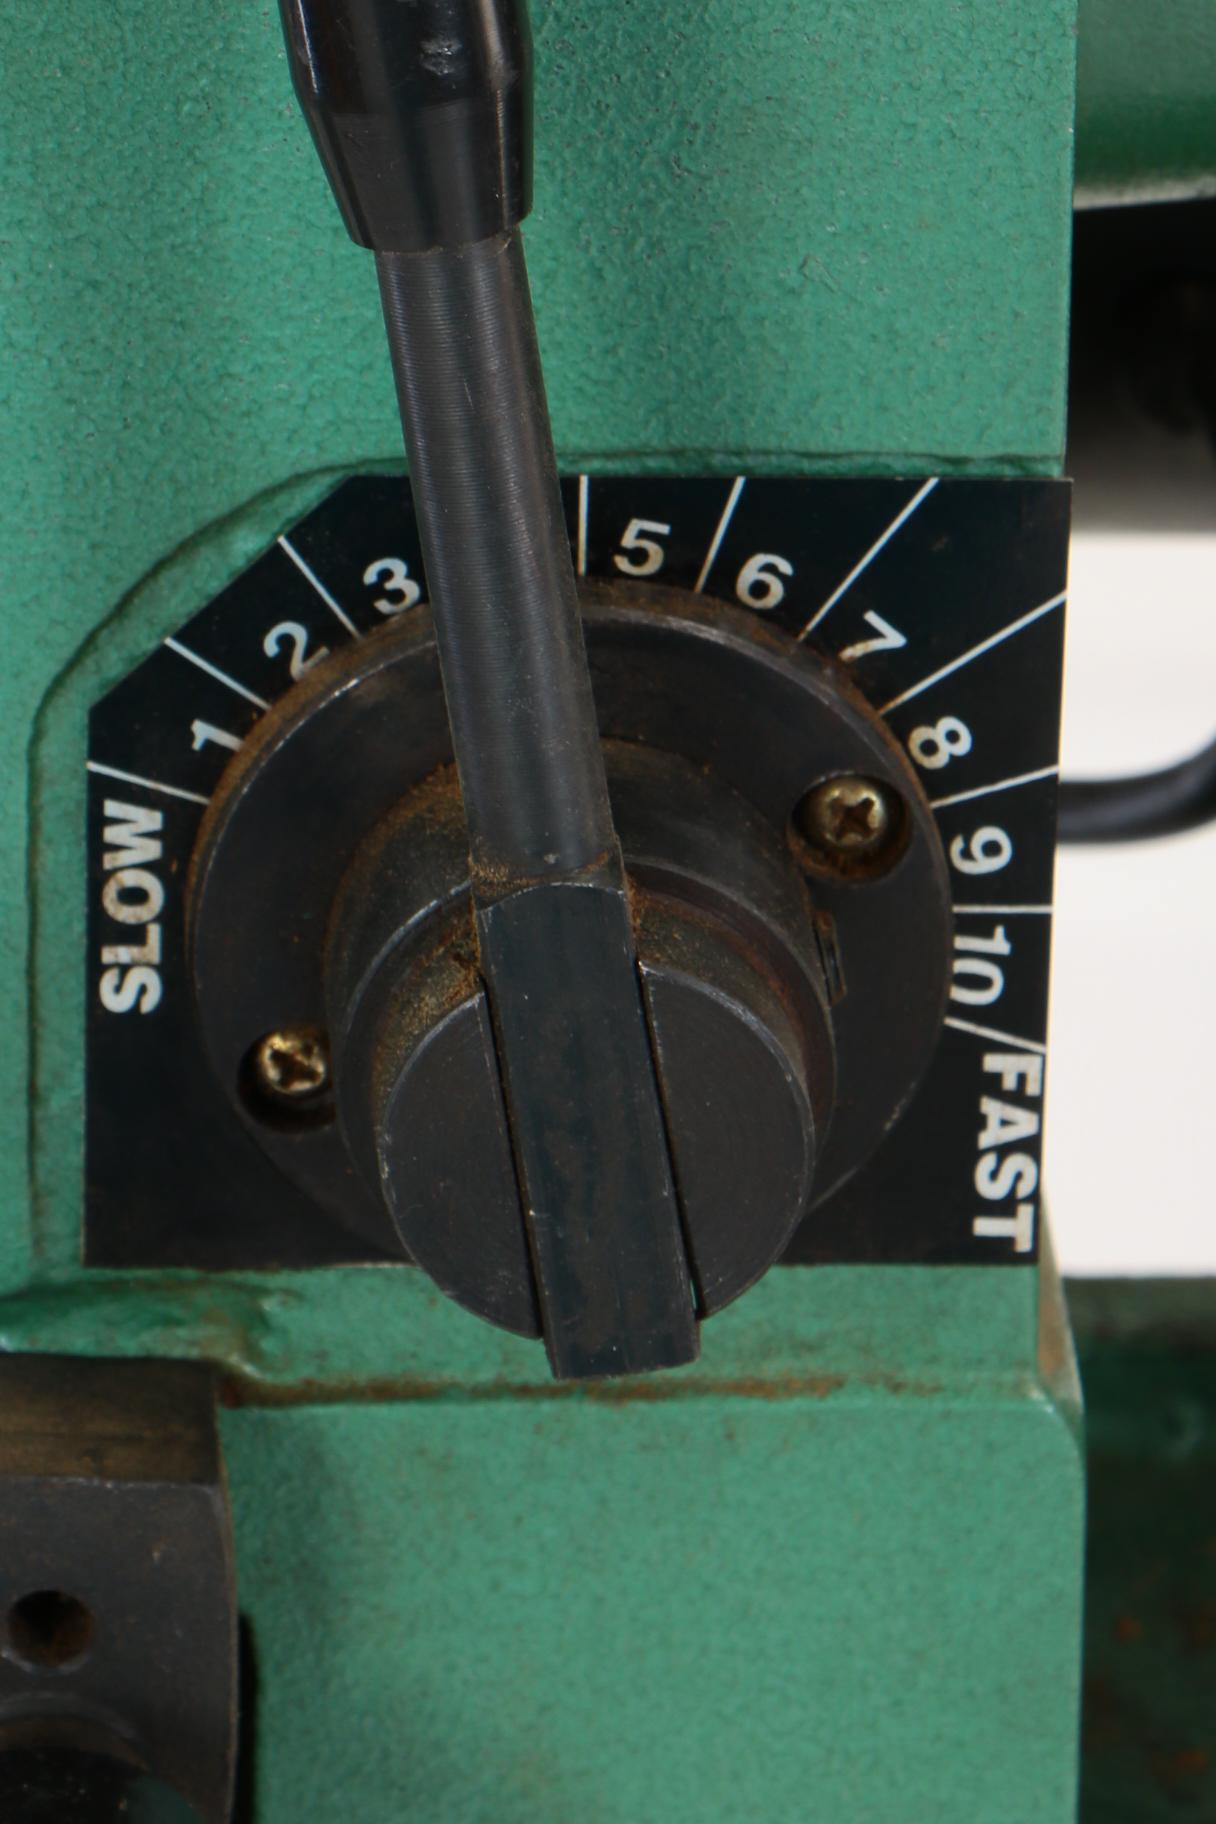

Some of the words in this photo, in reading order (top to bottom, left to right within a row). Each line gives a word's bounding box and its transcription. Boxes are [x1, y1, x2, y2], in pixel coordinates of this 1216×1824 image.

[614, 518, 671, 576] 5
[363, 557, 421, 614] 3
[736, 553, 794, 608] 6
[263, 621, 328, 680] 2
[841, 610, 907, 660] 7
[191, 719, 243, 751] 1
[909, 716, 972, 769] 8
[950, 826, 1013, 875] 9
[99, 799, 164, 1014] SLOW
[949, 925, 1011, 1005] 10
[972, 1052, 1045, 1253] FAST
